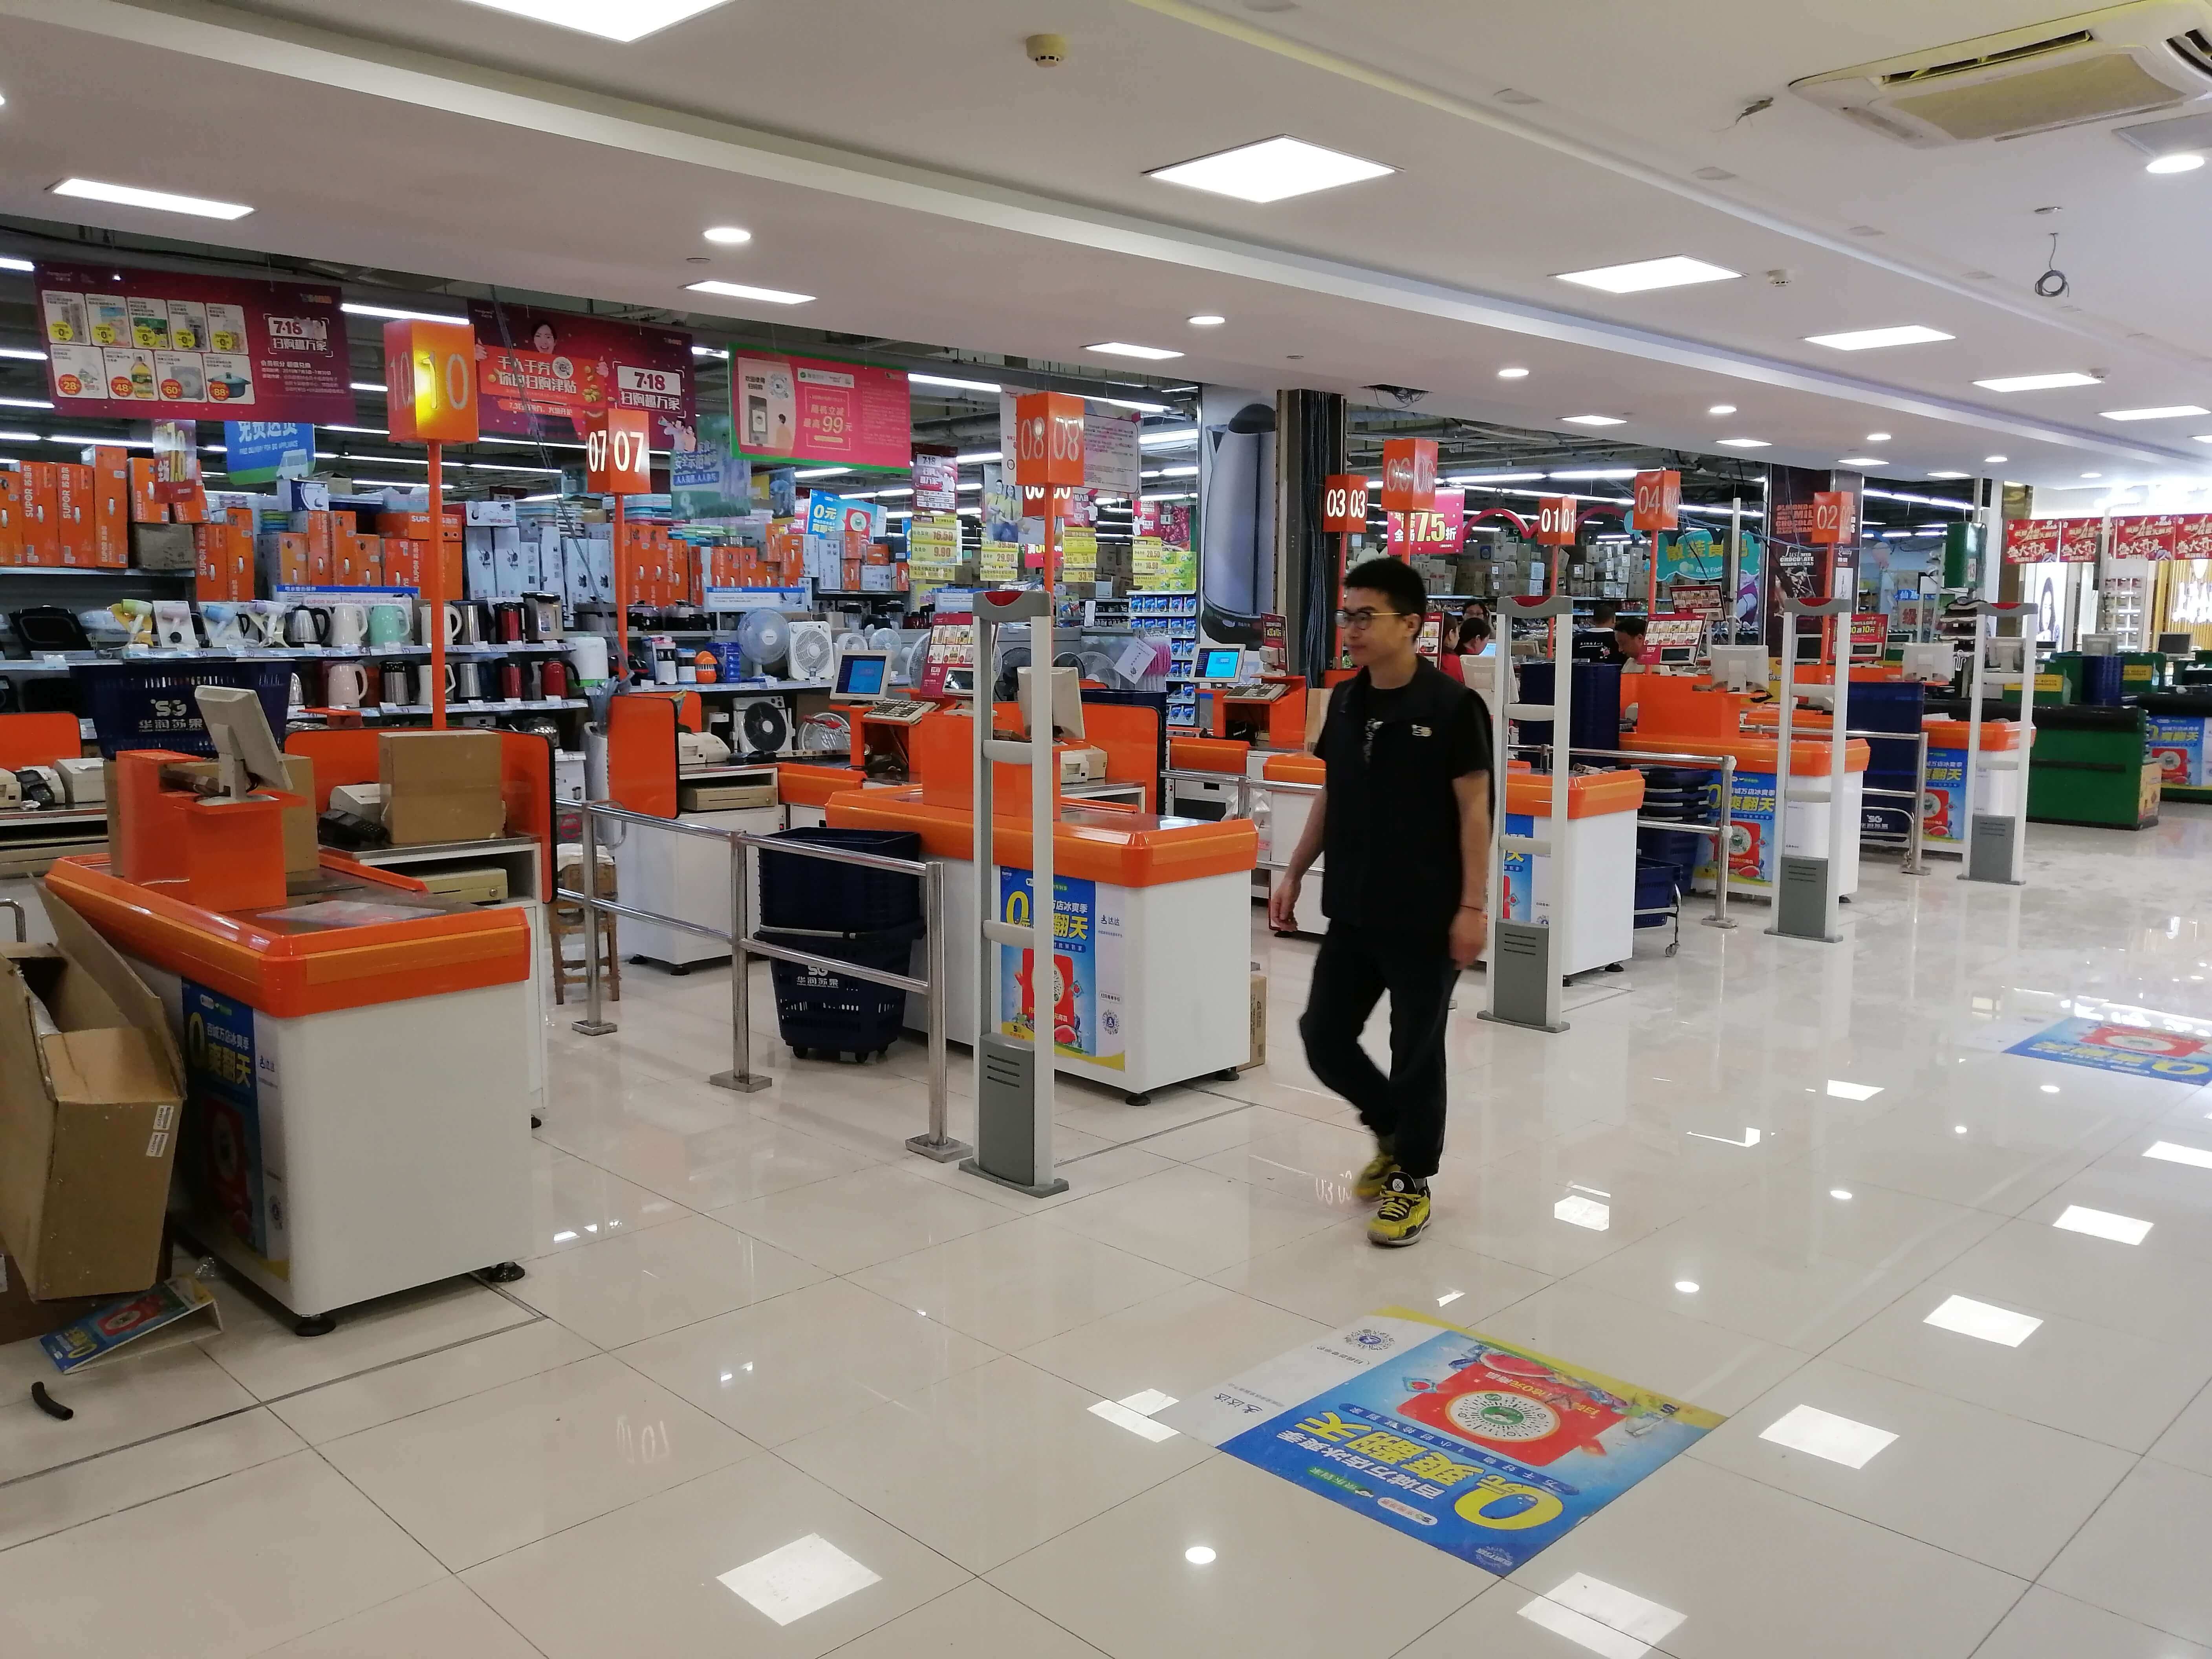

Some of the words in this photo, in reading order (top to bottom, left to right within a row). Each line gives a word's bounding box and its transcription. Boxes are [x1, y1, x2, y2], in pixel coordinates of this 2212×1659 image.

[421, 352, 469, 410] 10
[589, 430, 607, 472] 07
[614, 430, 644, 473] 07
[1021, 417, 1045, 460] 08
[1053, 416, 1079, 461] 08
[1387, 458, 1411, 492] 06
[1417, 458, 1434, 494] 06
[25, 489, 33, 517] SUPOR
[62, 490, 71, 519] SUPOR
[1327, 489, 1346, 517] 03
[1350, 489, 1366, 518] 03
[1638, 485, 1661, 515] 04
[1542, 507, 1559, 533] 01
[1563, 508, 1575, 533] 01
[1817, 505, 1838, 530] 02
[932, 531, 953, 541] 16.50
[2062, 540, 2096, 557] 盛大开
[2176, 537, 2212, 554] 盛大开
[1295, 1410, 1485, 1487] 爽翻天
[1276, 1430, 1447, 1500] 百城万店冰爽季
